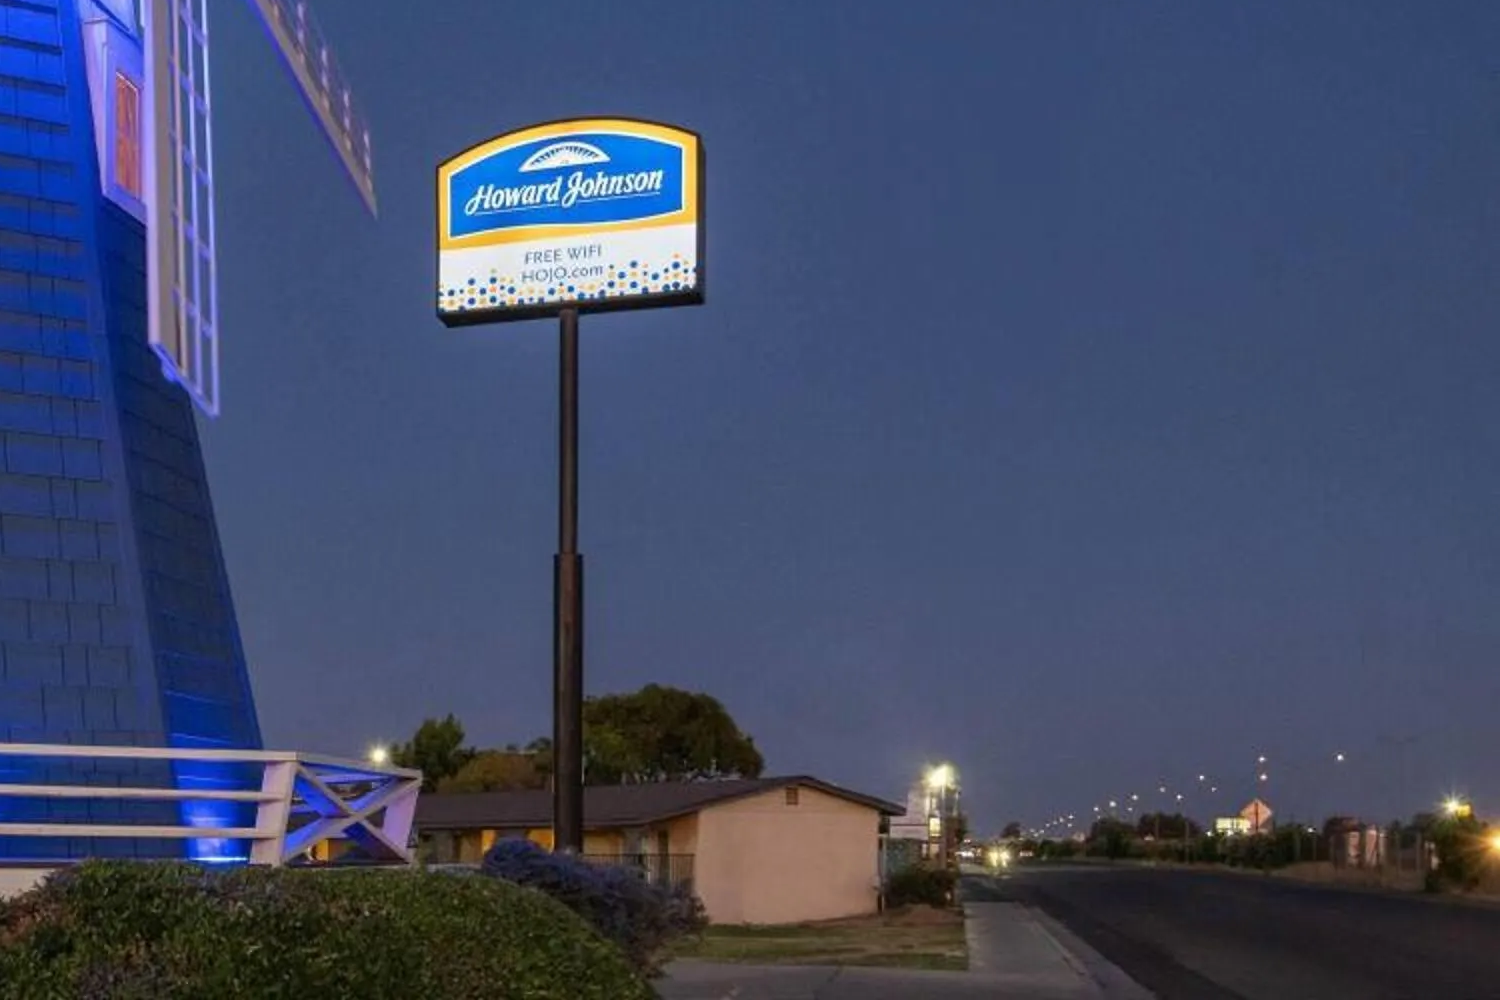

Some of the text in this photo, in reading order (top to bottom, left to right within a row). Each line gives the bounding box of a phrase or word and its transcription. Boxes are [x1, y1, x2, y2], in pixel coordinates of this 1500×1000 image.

[464, 169, 664, 216] Howard Johnson
[524, 243, 602, 264] FREE WIFI
[521, 265, 604, 284] HOJO.com
